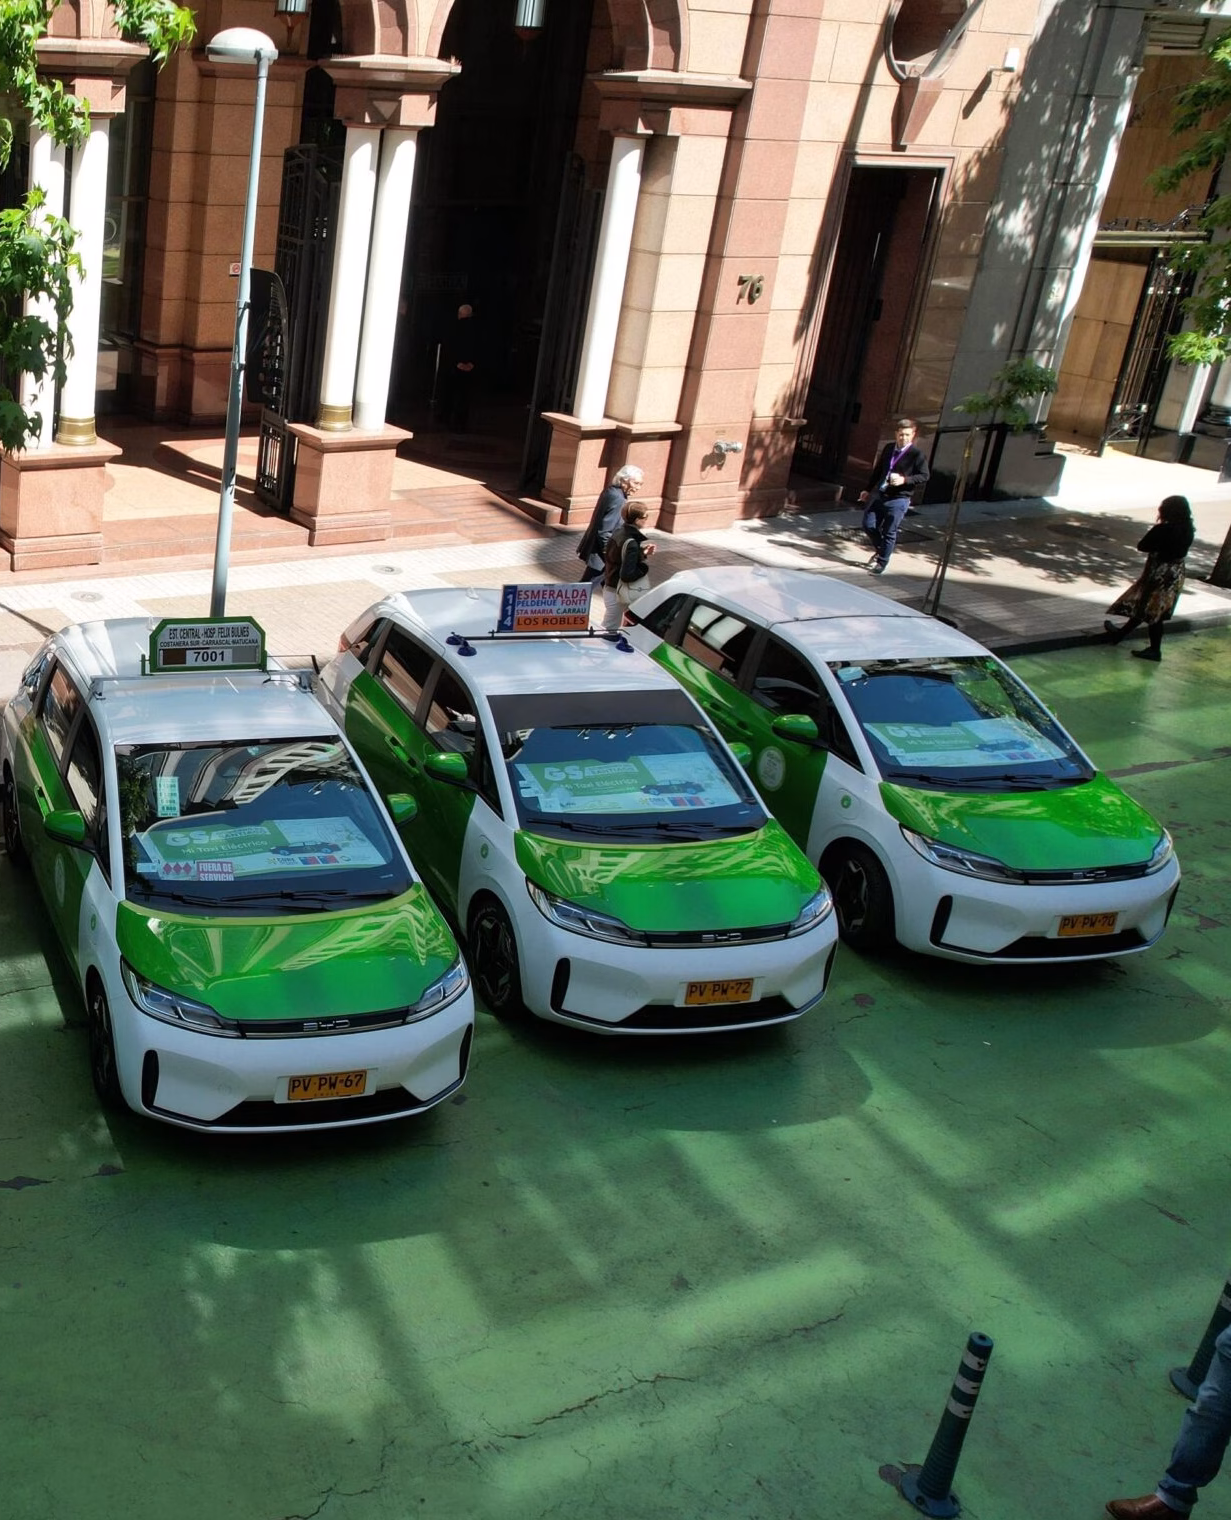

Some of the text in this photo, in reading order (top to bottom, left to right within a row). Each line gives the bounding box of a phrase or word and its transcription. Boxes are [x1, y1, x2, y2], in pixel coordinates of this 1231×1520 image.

[737, 275, 765, 304] 76
[517, 589, 587, 600] ESMERALDA
[516, 599, 557, 607] PELDEHUE
[517, 616, 585, 626] LOS ROBLES
[180, 627, 201, 640] CENTRAL
[231, 626, 249, 638] BULNES
[160, 640, 189, 648] COSTANERA
[193, 651, 225, 663] 7001
[544, 765, 583, 780] GS
[166, 830, 209, 847] GS
[199, 862, 233, 872] FUERA DE
[199, 873, 234, 881] SERVICIO
